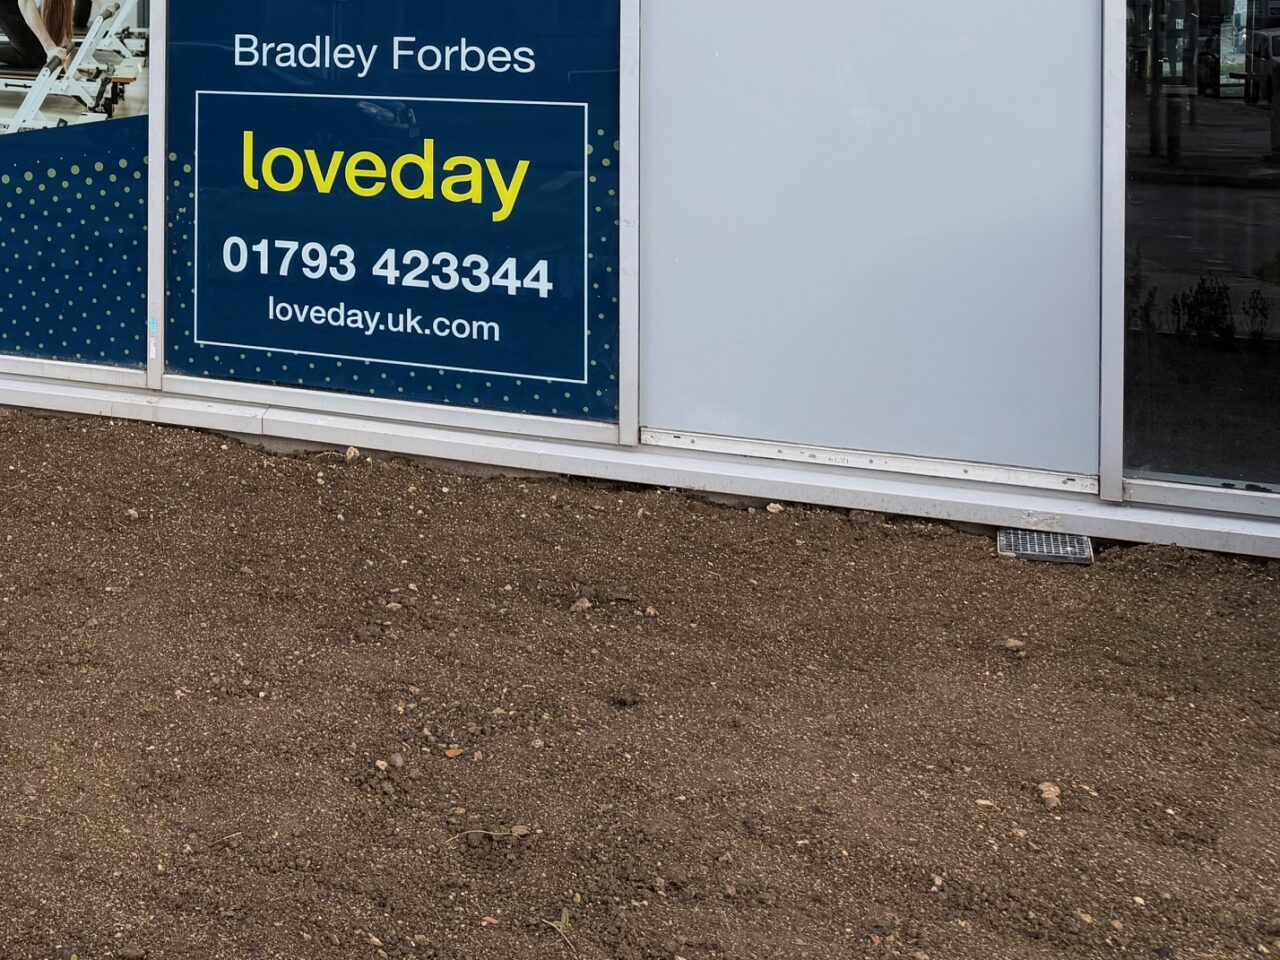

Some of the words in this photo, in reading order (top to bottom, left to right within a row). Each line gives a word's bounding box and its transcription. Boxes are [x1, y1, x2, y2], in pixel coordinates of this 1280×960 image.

[234, 33, 378, 78] Bradley
[393, 36, 537, 74] Forbes
[243, 130, 530, 222] loveday
[222, 236, 356, 282] 01793
[372, 248, 553, 298] 423344
[269, 295, 500, 342] loveday.uk.com
